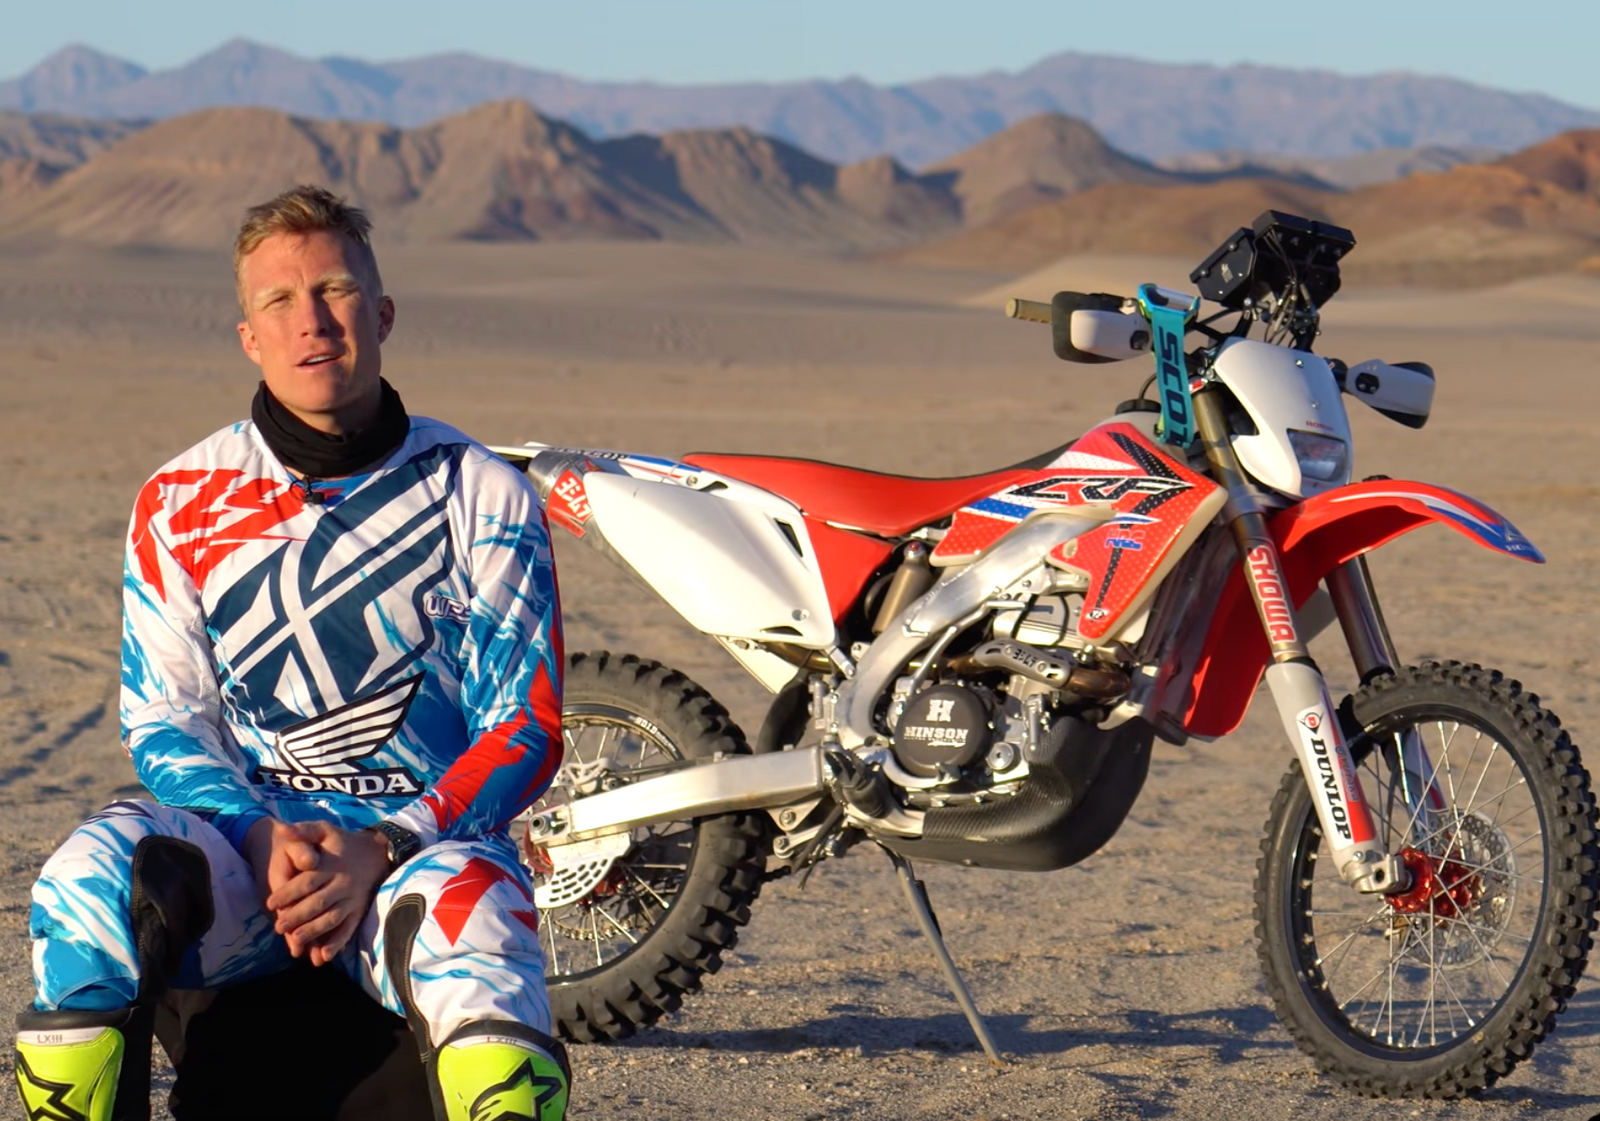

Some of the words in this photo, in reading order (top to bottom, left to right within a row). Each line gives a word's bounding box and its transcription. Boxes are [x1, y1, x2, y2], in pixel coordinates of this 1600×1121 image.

[1248, 545, 1298, 643] SHOWA
[904, 726, 969, 740] HINSON
[258, 771, 418, 796] HONDA
[1311, 738, 1352, 840] DUNLOP
